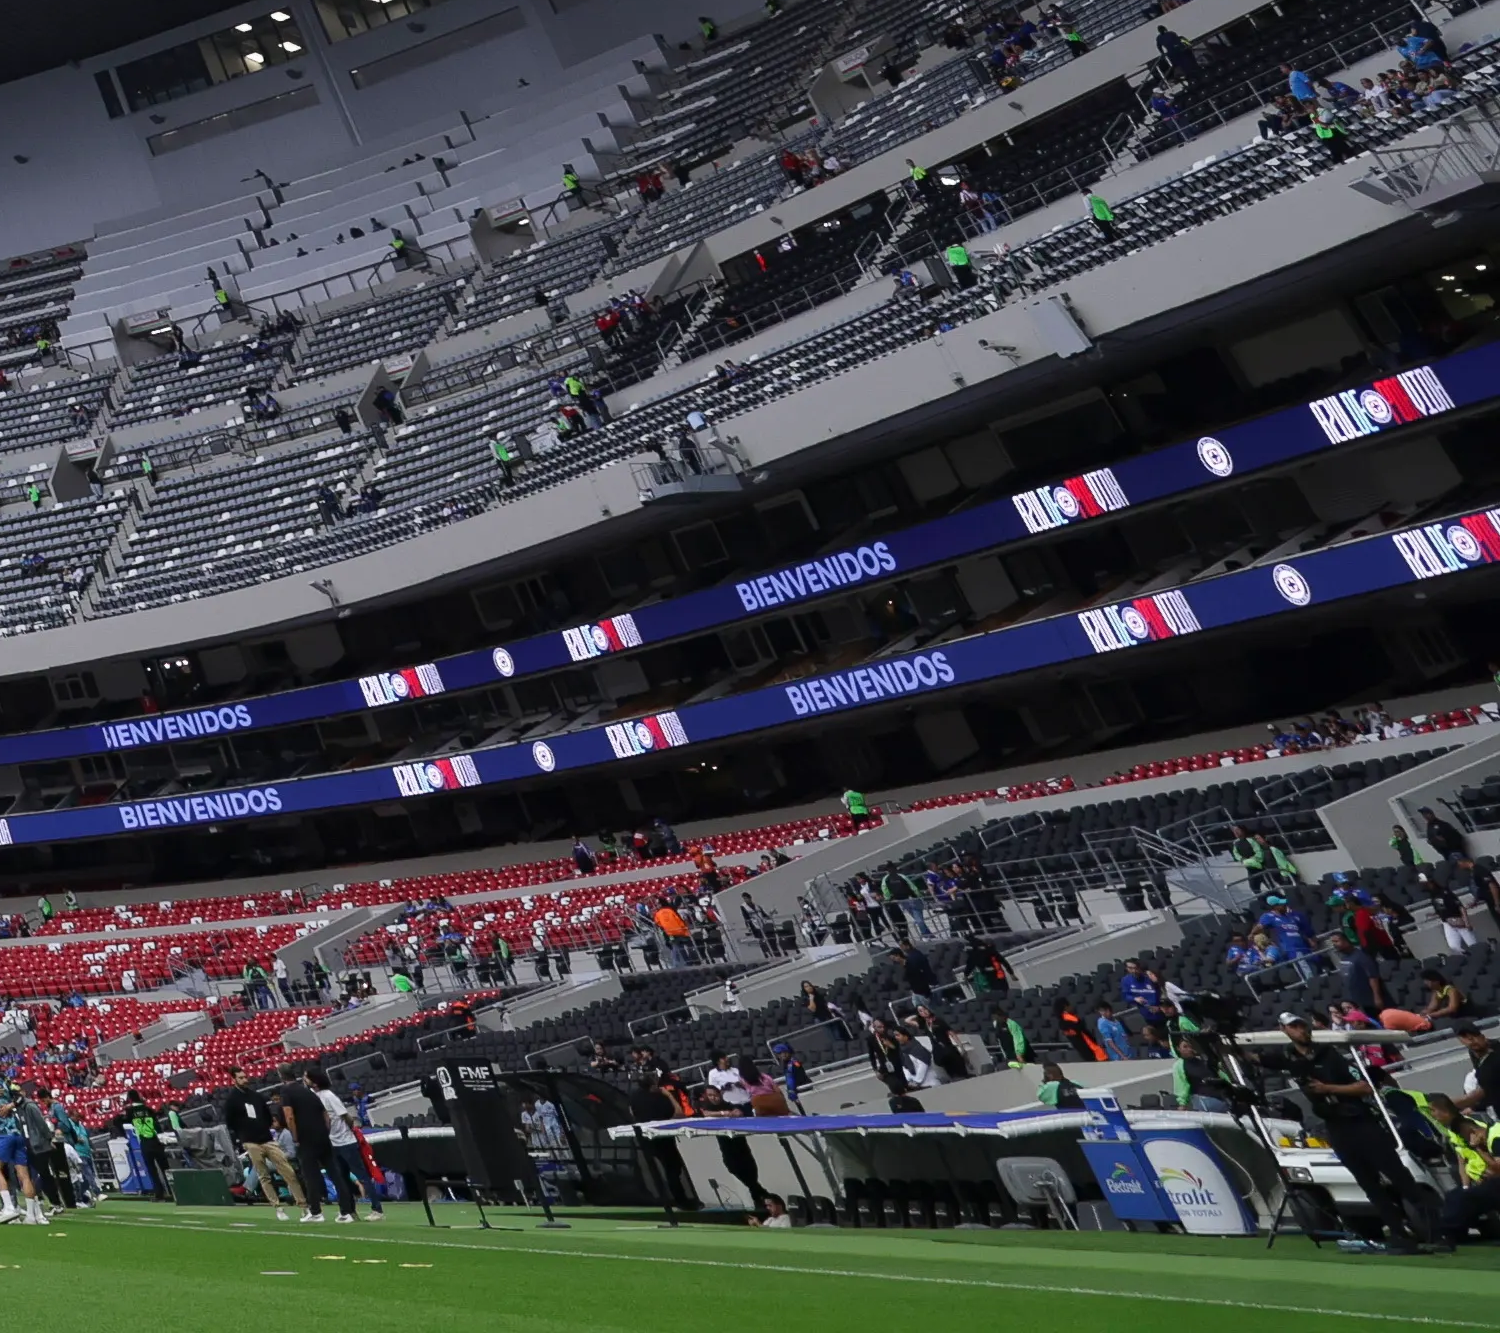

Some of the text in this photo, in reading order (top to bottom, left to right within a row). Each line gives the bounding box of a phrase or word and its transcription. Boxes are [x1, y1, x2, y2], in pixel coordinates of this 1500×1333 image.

[735, 541, 896, 612] BIENVENIDOS
[785, 651, 955, 715] BIENVENIDOS
[118, 787, 283, 829] BIENVENIDOS
[458, 1066, 490, 1079] FMF
[1105, 1178, 1146, 1194] Electrolit
